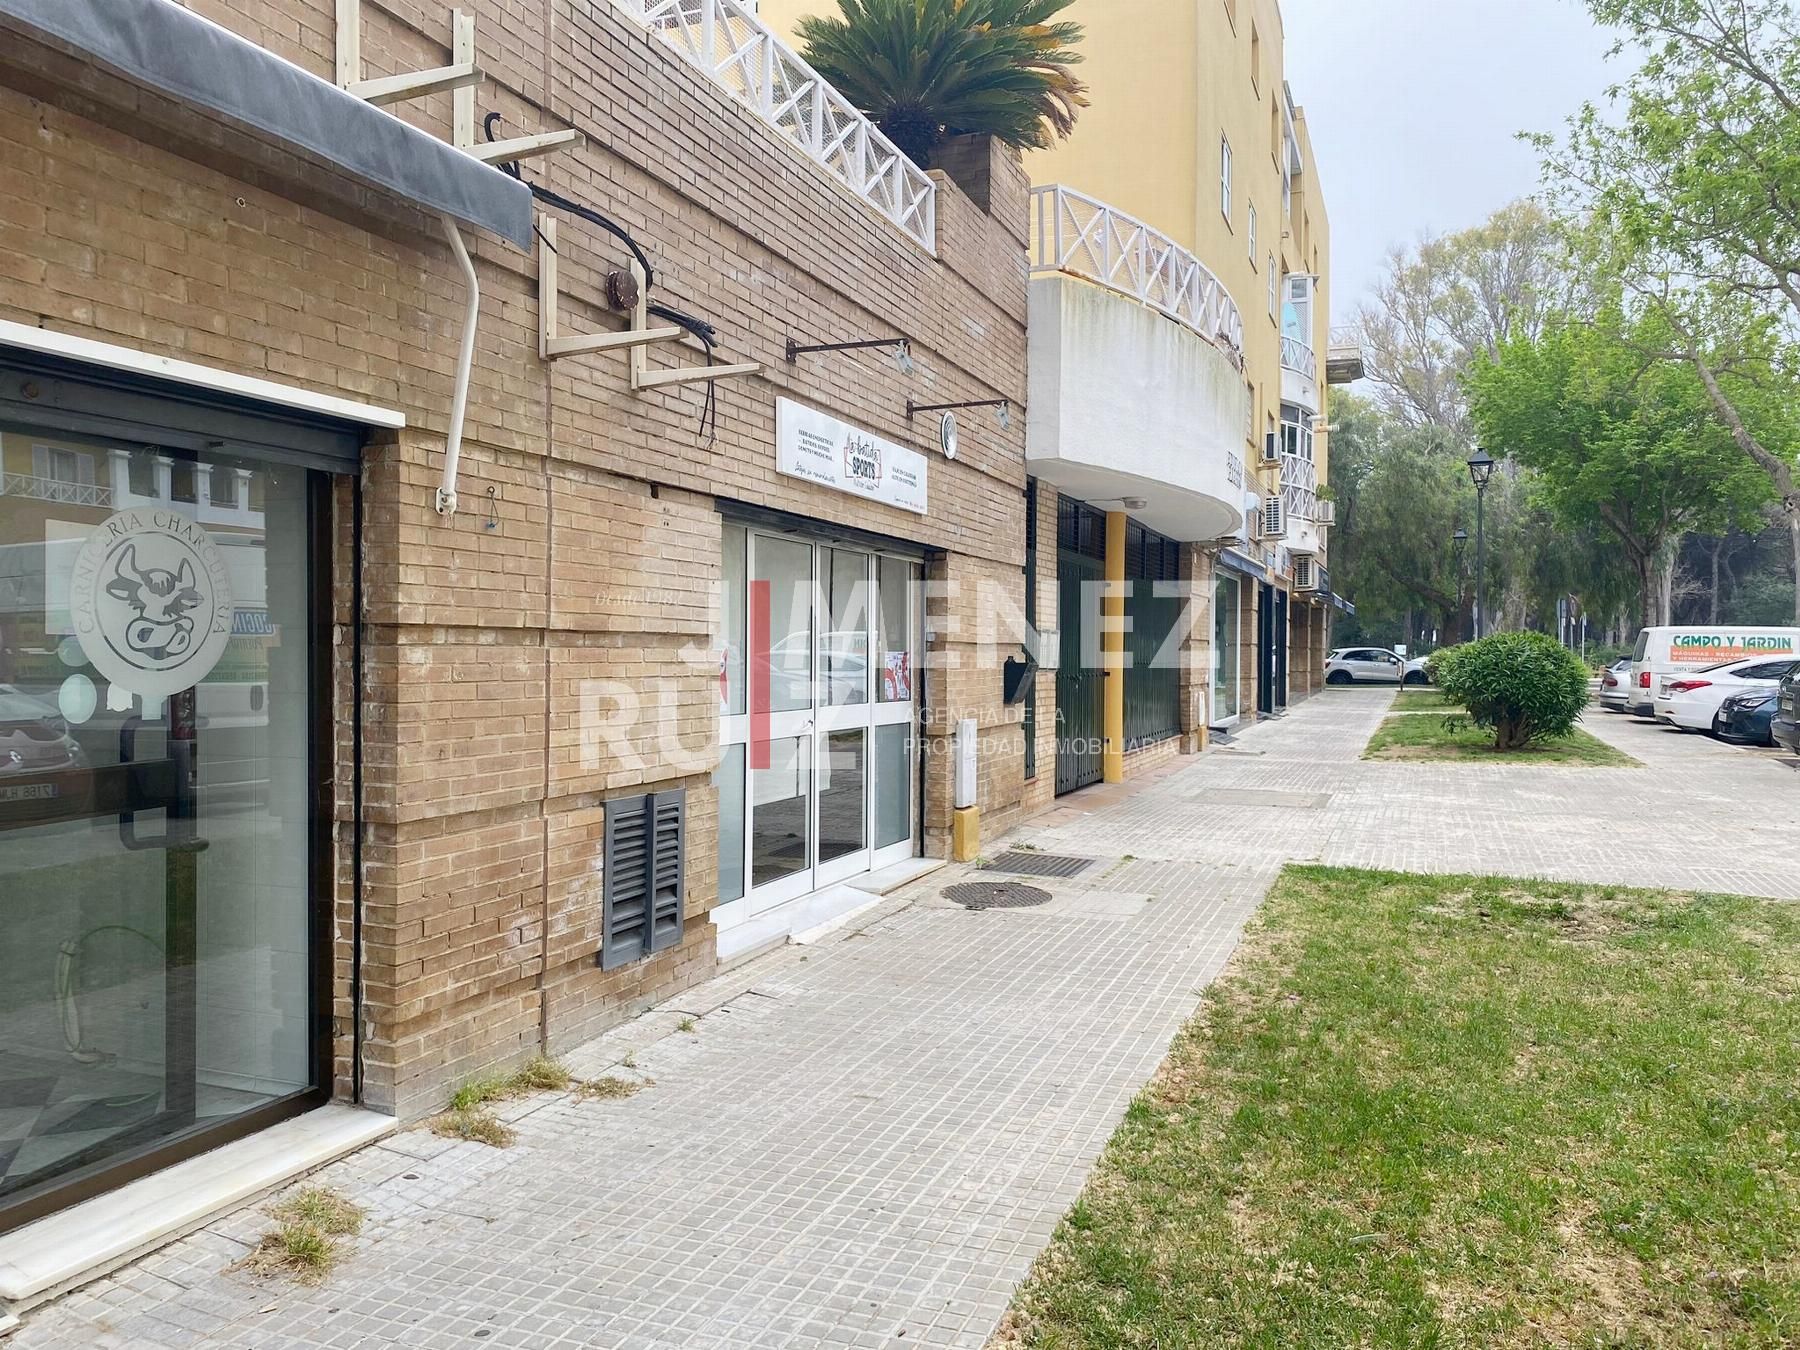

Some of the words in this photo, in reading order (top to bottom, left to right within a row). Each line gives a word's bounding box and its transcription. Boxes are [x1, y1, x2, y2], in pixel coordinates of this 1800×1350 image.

[852, 457, 877, 480] SPORTS
[79, 512, 143, 634] CARNICERIA
[153, 511, 231, 634] CHARCUTERIA
[1673, 635, 1721, 648] CAMPO
[1726, 636, 1735, 648] Y
[1741, 637, 1792, 649] JARDIN
